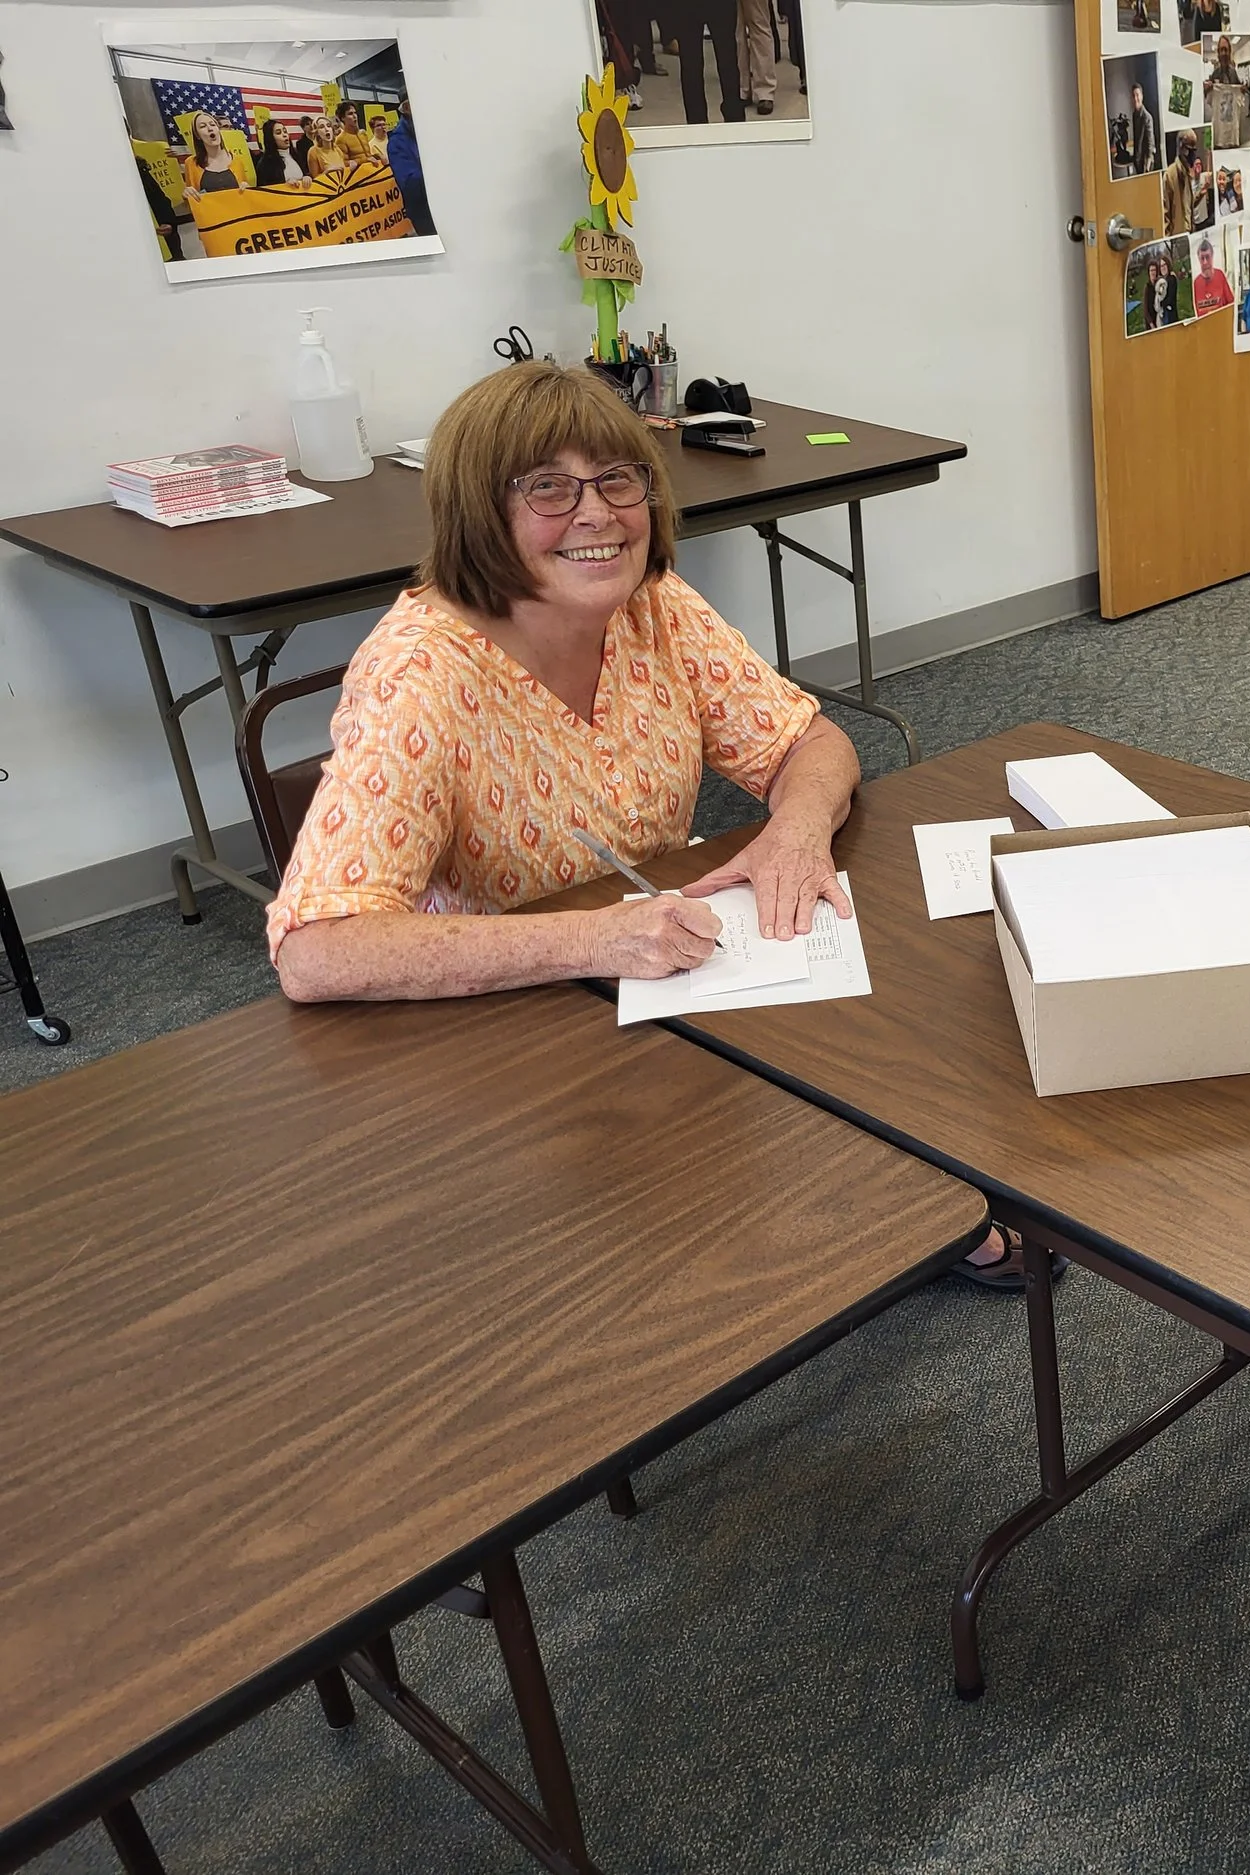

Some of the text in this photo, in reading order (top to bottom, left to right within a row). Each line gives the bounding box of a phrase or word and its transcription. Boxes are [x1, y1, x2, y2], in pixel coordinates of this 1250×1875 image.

[153, 169, 169, 178] THE
[235, 223, 313, 255] GREEN
[315, 205, 349, 237] NEW
[349, 198, 385, 218] DEAL
[355, 221, 381, 243] STEP
[383, 207, 407, 229] ASIDE
[580, 235, 635, 256] CLIMAT
[584, 256, 641, 279] JUSTICE
